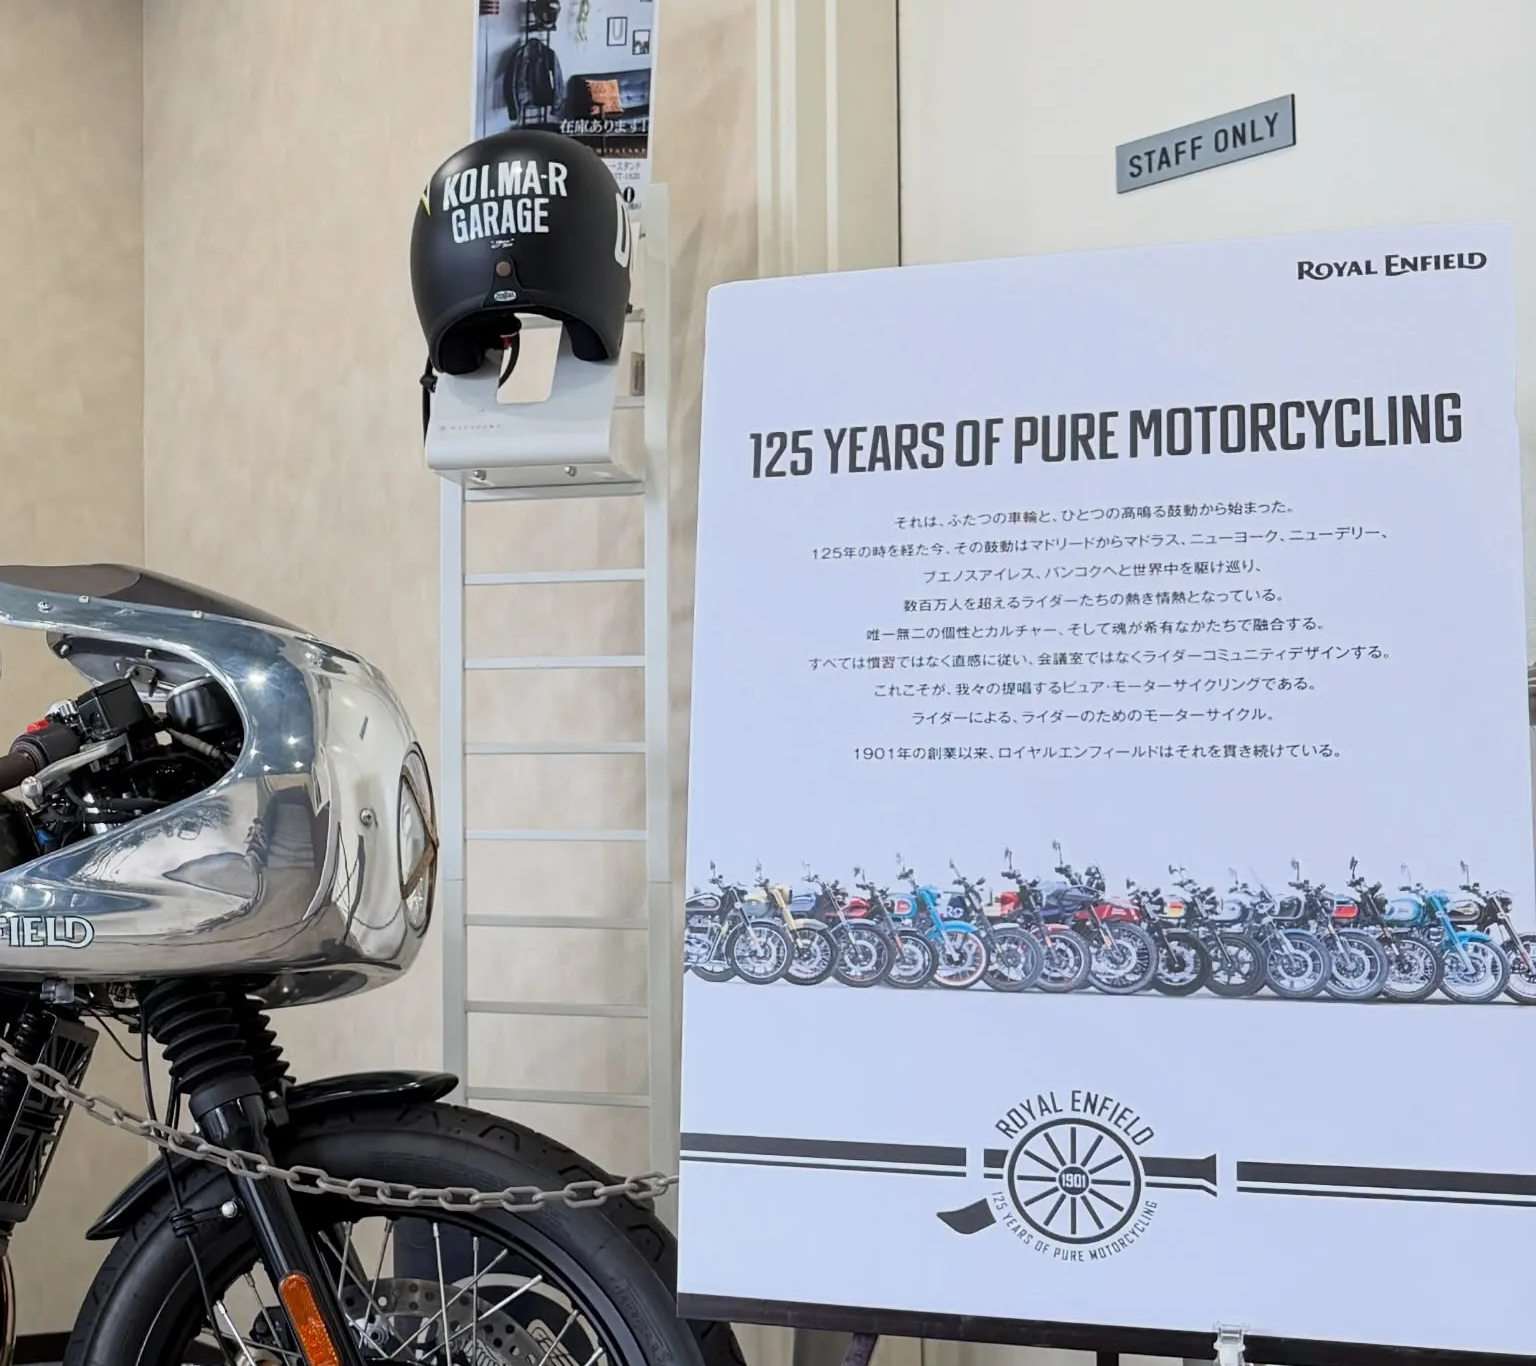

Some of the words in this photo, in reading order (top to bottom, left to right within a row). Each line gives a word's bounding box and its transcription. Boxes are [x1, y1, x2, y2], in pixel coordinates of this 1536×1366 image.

[1129, 136, 1203, 178] STAFF
[1214, 112, 1278, 153] ONLY
[452, 198, 549, 244] GARAGE
[1297, 260, 1378, 280] ROYAL
[1385, 252, 1487, 277] ENFIELD
[749, 429, 813, 479] 125
[823, 421, 944, 475] YEARS
[955, 417, 1003, 467] OF
[1014, 410, 1119, 465] PURE
[1129, 392, 1462, 459] MOTORCYCLING
[903, 588, 1283, 613] 数百万人を超えるライダーたちの熱き情熱となっている。
[912, 707, 1274, 725] ライダーによる、ライダーのためのモーターサイクル。
[995, 1091, 1063, 1139] ROYAL
[1071, 1090, 1154, 1146] ENFIELD
[1061, 1173, 1086, 1188] 1901
[991, 1191, 1007, 1212] 125
[1001, 1212, 1033, 1245] YEARS
[1034, 1240, 1050, 1254] OF
[1053, 1247, 1085, 1262] PURE
[1089, 1199, 1158, 1262] MOTORCYCLING
